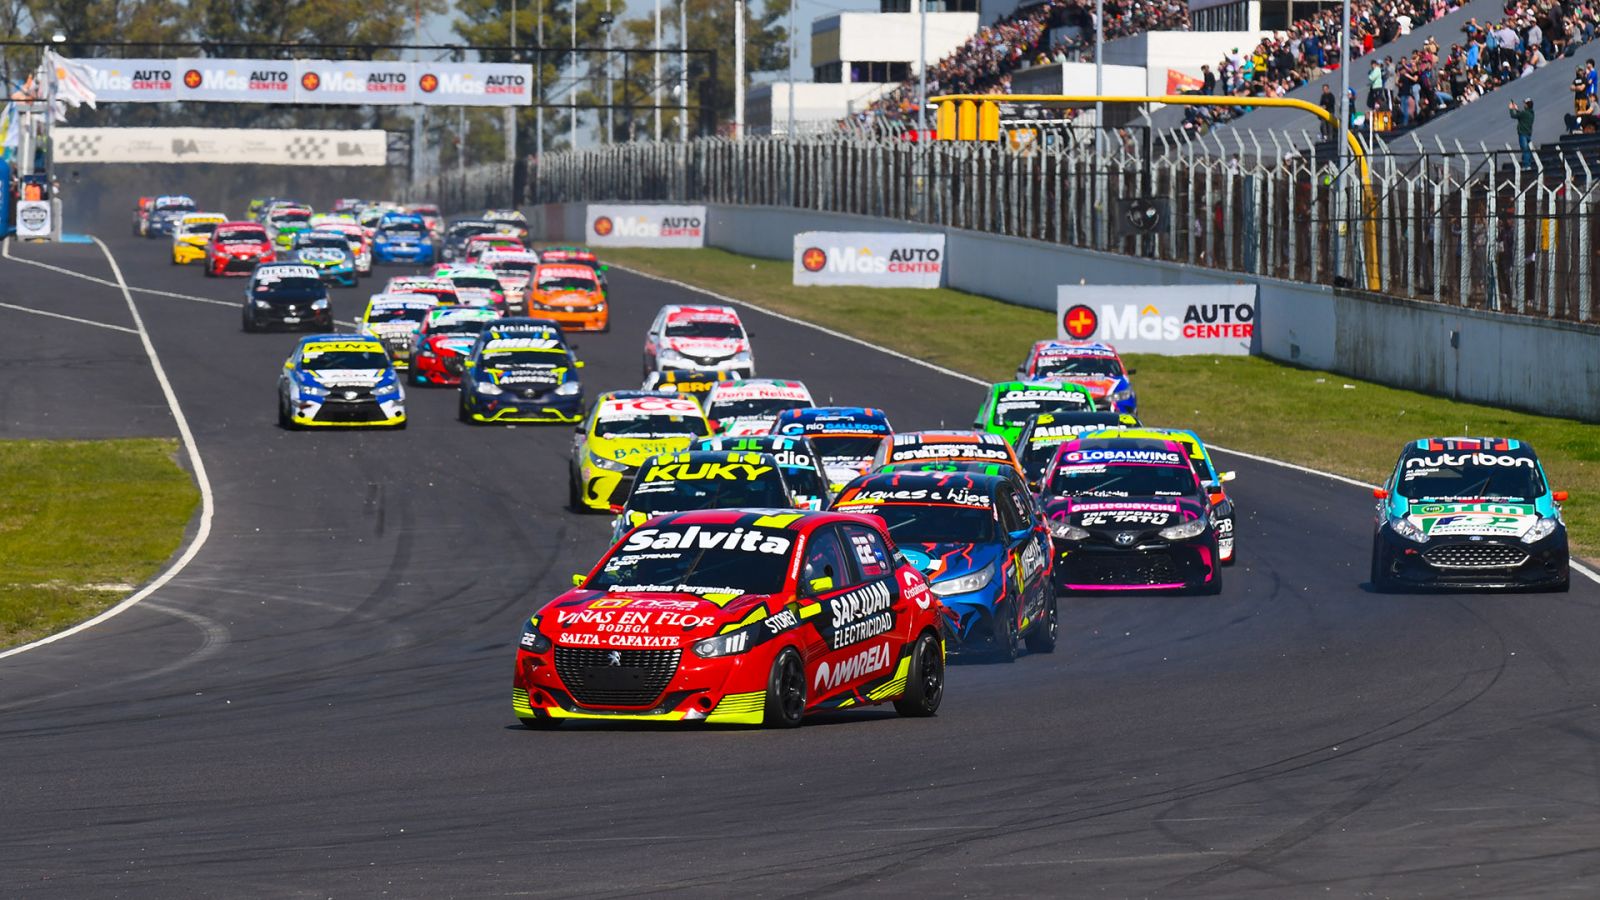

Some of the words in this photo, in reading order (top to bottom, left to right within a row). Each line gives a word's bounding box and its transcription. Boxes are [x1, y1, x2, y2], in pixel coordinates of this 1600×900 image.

[133, 70, 171, 81] AUTO
[250, 71, 288, 82] AUTO
[368, 73, 406, 83] AUTO
[486, 75, 525, 85] AUTO
[662, 217, 701, 228] AUTO
[889, 248, 940, 262] AUTO
[888, 262, 940, 273] CENTER
[1183, 304, 1255, 324] AUTO
[1183, 323, 1254, 339] CENTER
[607, 399, 697, 412] TCG
[825, 422, 886, 431] GALLEGOS
[775, 451, 810, 466] dio
[1065, 450, 1180, 462] GLOBALWING
[1406, 453, 1535, 468] nutribon
[644, 463, 773, 481] KUKY
[622, 525, 791, 555] Salvita
[609, 583, 674, 593] Parabrisas
[676, 584, 745, 596] Pergamino
[830, 590, 861, 629] SAN
[856, 580, 892, 618] JUAN
[556, 609, 616, 624] VIÑAS
[618, 611, 653, 625] EN
[655, 611, 716, 627] FLOR
[764, 610, 798, 634] STOREY
[597, 623, 650, 633] BODEGA
[833, 611, 892, 649] ELECTRICIDAD
[559, 632, 600, 645] SALTA
[608, 634, 681, 647] CAFAYATE
[828, 641, 890, 689] AMARELA
